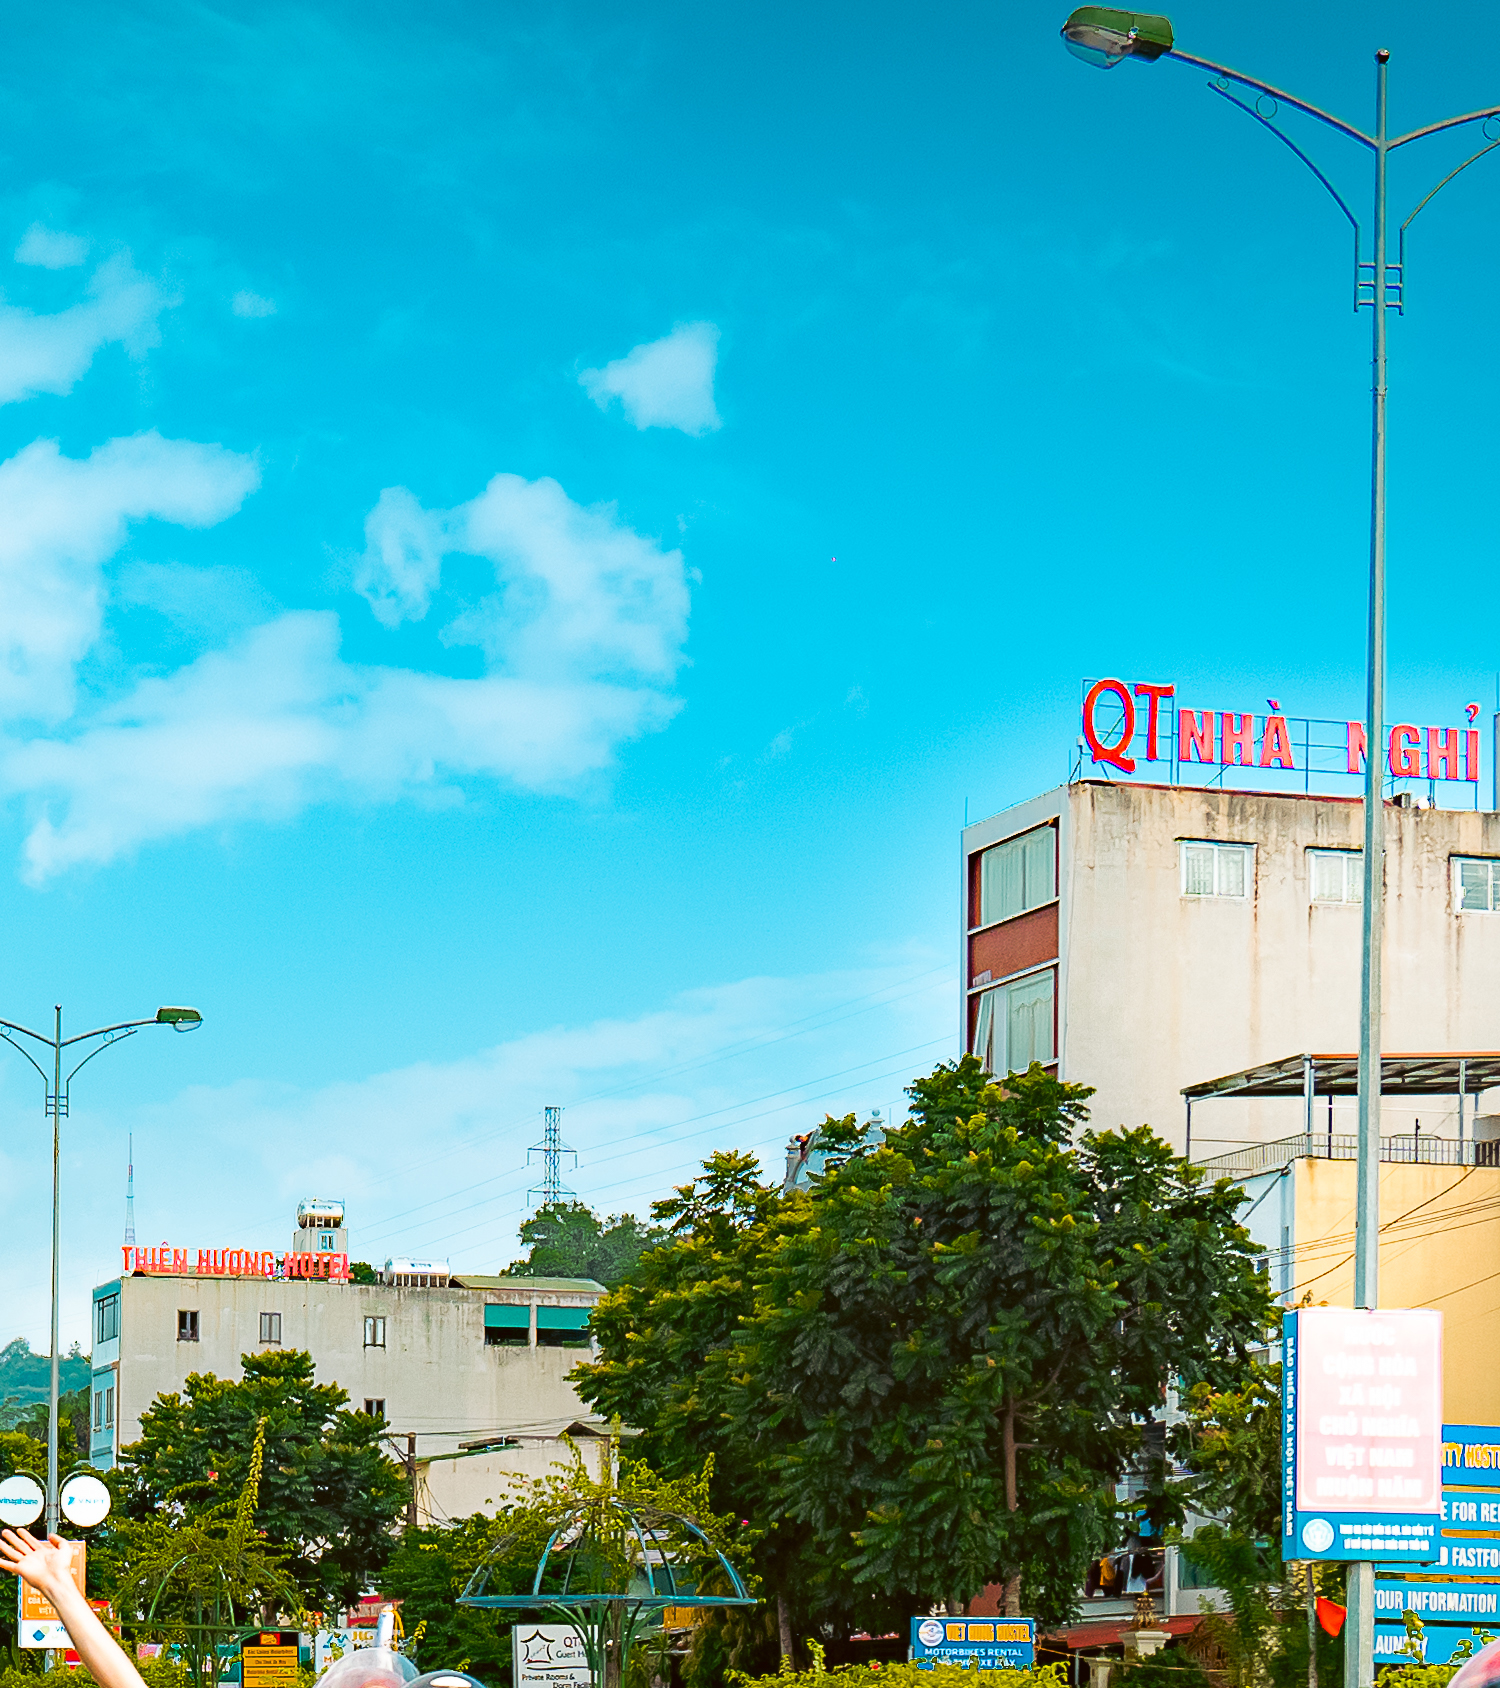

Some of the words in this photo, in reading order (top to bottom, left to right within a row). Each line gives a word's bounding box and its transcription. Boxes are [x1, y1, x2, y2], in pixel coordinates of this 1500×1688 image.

[1083, 679, 1175, 773] QT
[1179, 699, 1294, 769] NHÀ
[1346, 704, 1480, 782] NGHỈ
[121, 1241, 188, 1274] THIÊN
[197, 1247, 275, 1277] HƯƠNG
[283, 1250, 354, 1281] HOTEL
[1324, 1443, 1366, 1470] VIỆT
[1368, 1447, 1415, 1468] NAM
[0, 1496, 39, 1506] vinaphone
[1451, 1502, 1476, 1523] FOR
[1407, 1591, 1498, 1614] INFORMATION
[925, 1648, 986, 1656] MOTORBIKES
[988, 1648, 1023, 1656] RENTAL
[521, 1673, 544, 1681] Private
[545, 1673, 568, 1681] Rooms
